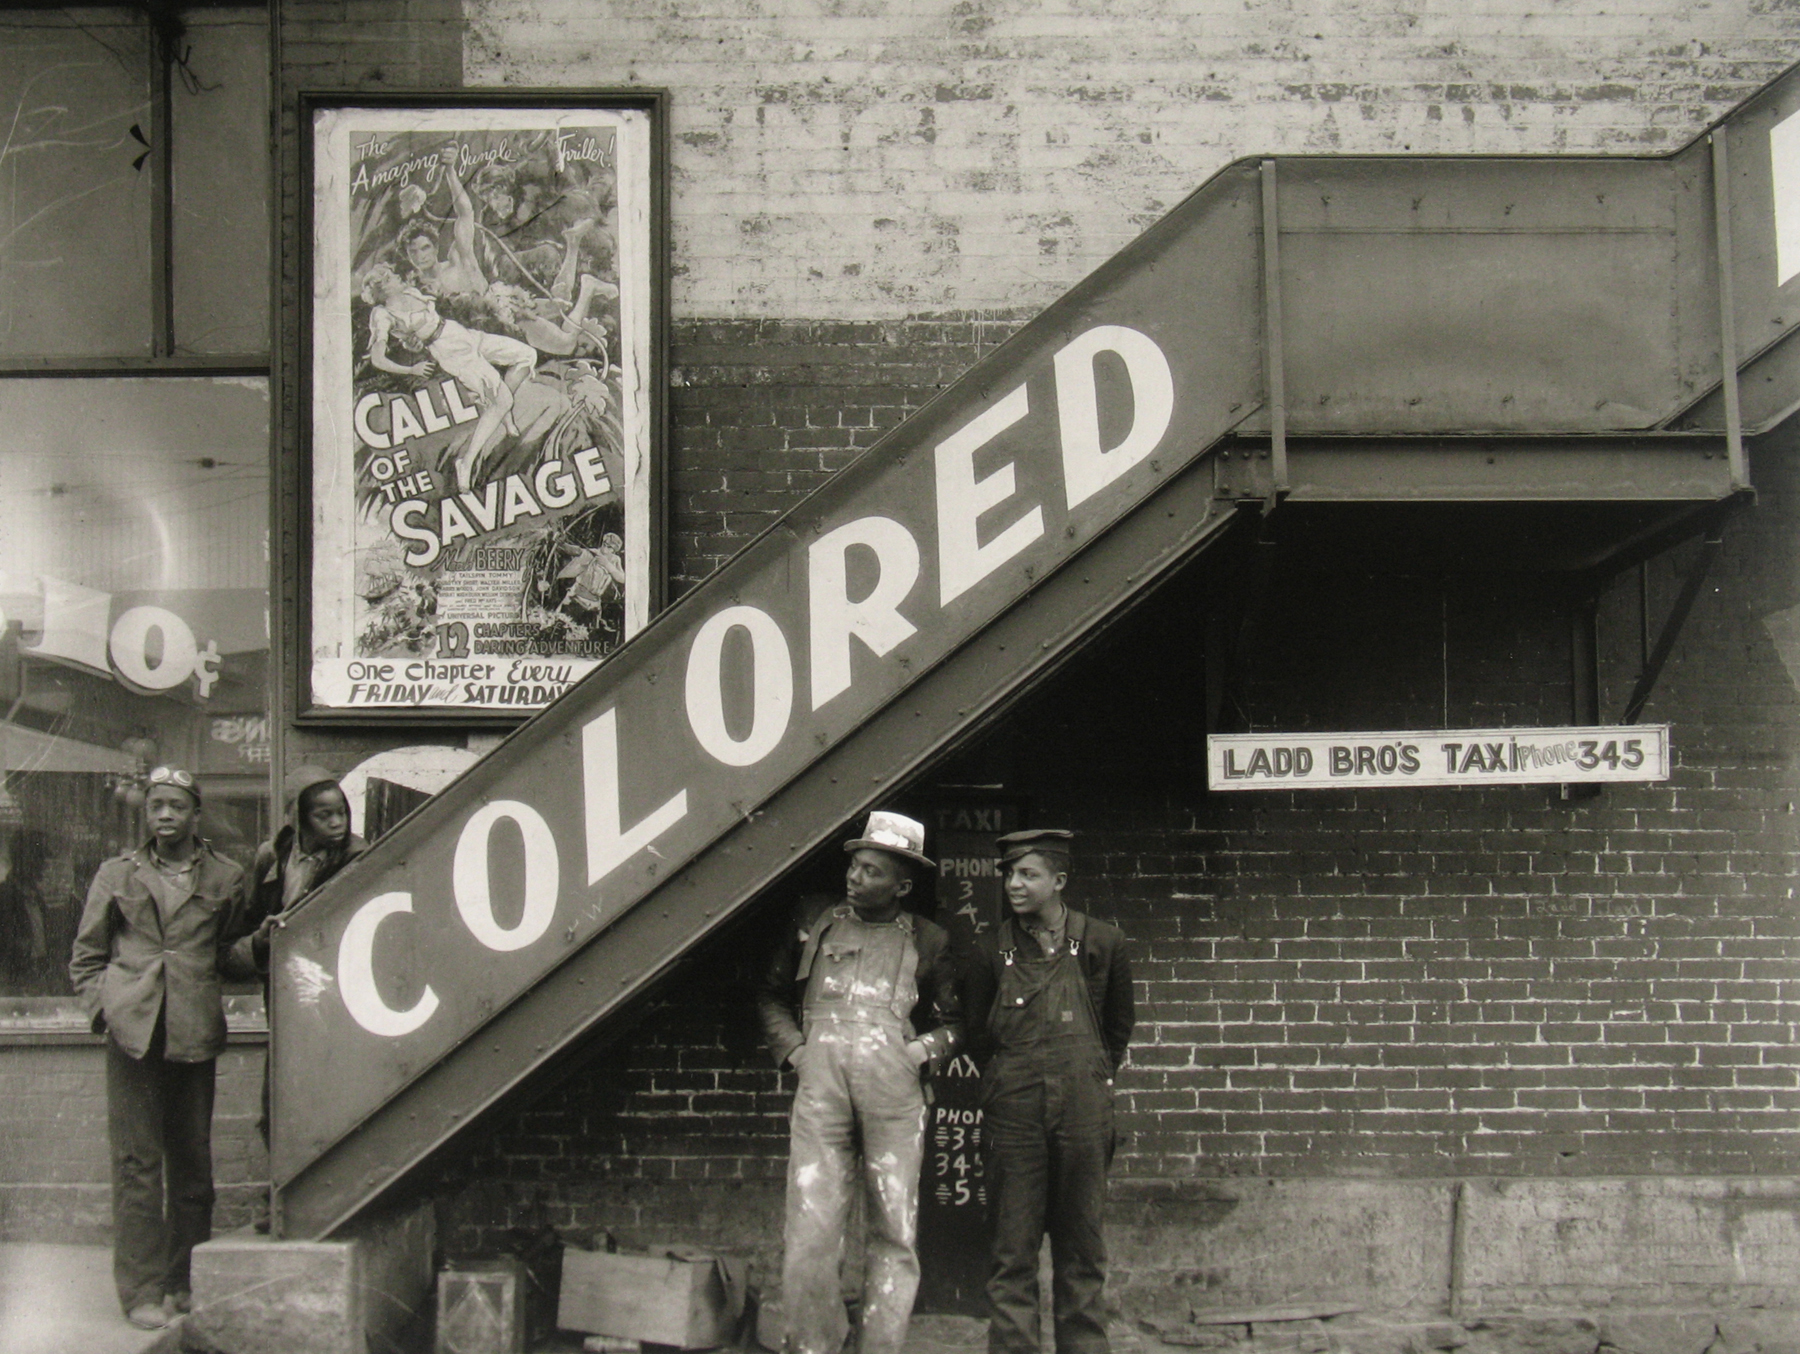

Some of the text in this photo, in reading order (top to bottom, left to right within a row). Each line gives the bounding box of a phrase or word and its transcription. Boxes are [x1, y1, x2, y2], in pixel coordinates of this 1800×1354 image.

[356, 135, 389, 160] The
[352, 132, 614, 195] Amazing Jungle Thriller!
[354, 380, 479, 448] CALL
[371, 450, 411, 480] OF
[381, 470, 434, 502] THE
[391, 447, 610, 566] SAVAGE
[475, 548, 525, 571] BEERY
[436, 621, 471, 659] 12
[474, 623, 540, 638] CHAPTERS
[474, 637, 610, 655] DARING ADVENTURE
[337, 324, 1175, 1037] COLORED
[347, 661, 395, 681] One
[507, 660, 573, 685] Every
[347, 684, 433, 705] FRIDAY
[1223, 747, 1313, 779] LADD
[1329, 741, 1420, 776] BRO'S
[1575, 739, 1644, 771] 345
[938, 809, 1001, 831] TAXI
